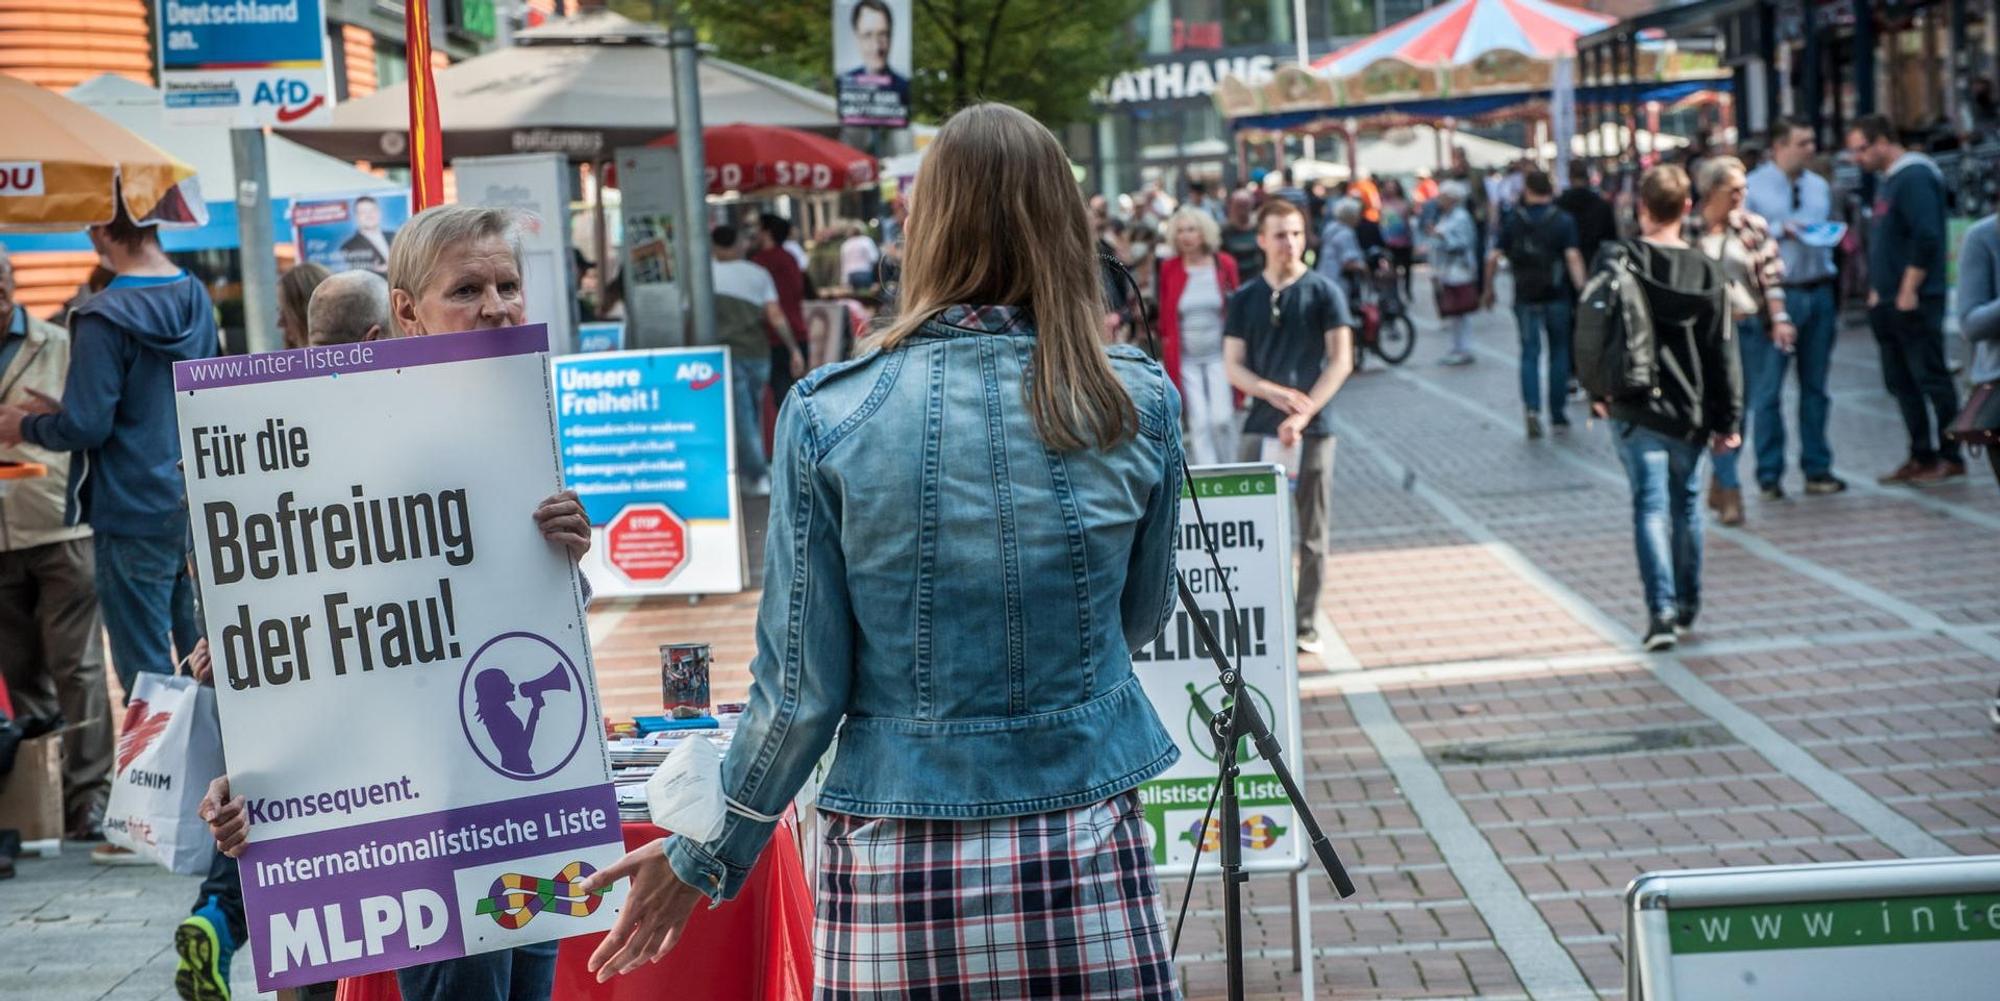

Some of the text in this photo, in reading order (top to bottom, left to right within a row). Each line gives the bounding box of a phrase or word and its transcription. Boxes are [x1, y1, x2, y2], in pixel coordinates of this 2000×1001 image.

[168, 30, 199, 49] an.
[253, 80, 309, 105] AfD
[1090, 55, 1274, 103] ATHAUS
[775, 160, 832, 189] SPD
[190, 344, 374, 382] www.inter-liste.de
[560, 369, 641, 389] Unsere
[676, 361, 713, 381] AfD
[560, 391, 648, 416] Freiheit
[192, 419, 310, 479] Für die
[203, 485, 474, 586] Befreiung
[222, 578, 462, 690] der Frau!
[130, 769, 171, 790] DENIM
[1238, 781, 1287, 800] Liste
[247, 775, 420, 825] Konsequent.
[256, 804, 607, 888] Internationalistische Liste
[269, 887, 449, 977] MLPD
